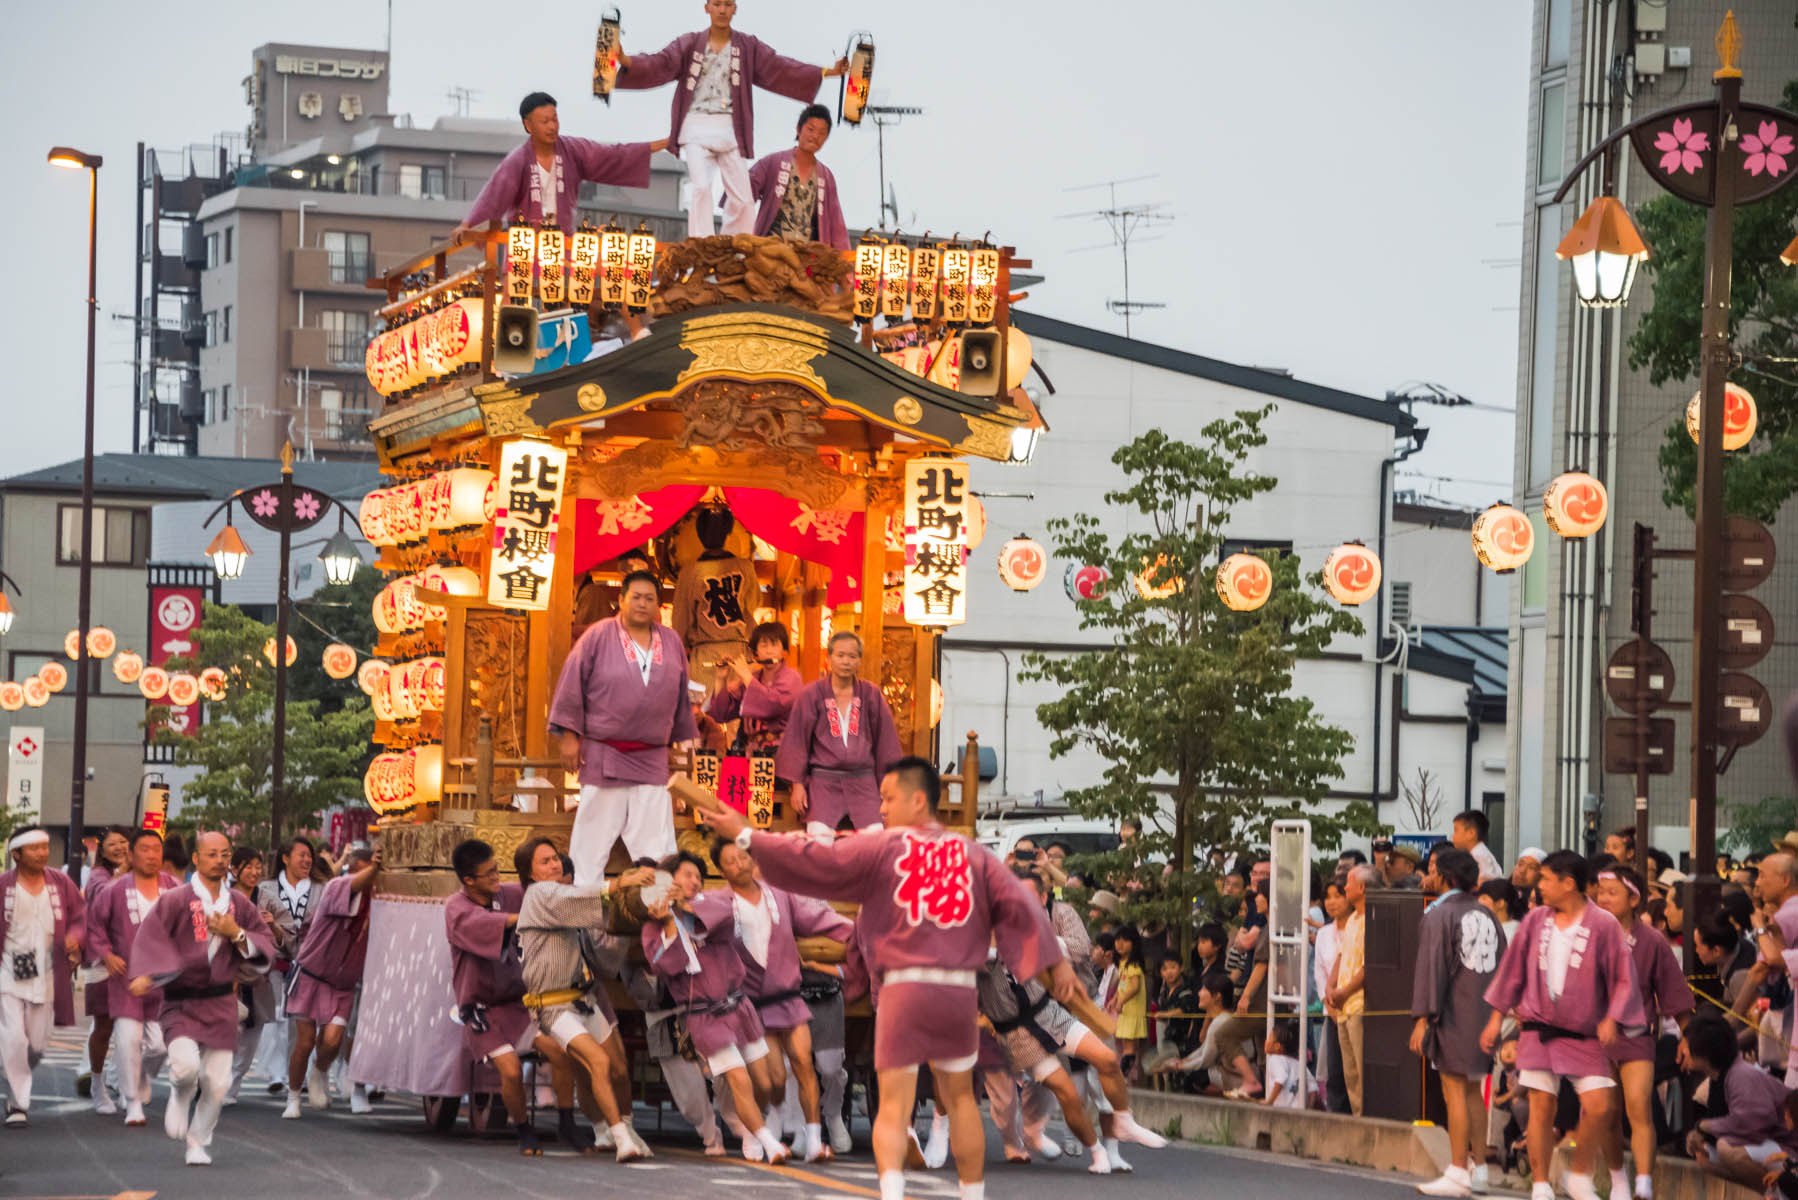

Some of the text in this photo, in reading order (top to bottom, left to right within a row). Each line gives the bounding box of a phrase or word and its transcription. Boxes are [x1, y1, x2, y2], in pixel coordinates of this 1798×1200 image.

[276, 55, 385, 80] 朝日プラザ
[498, 453, 560, 602] 北町櫻會
[911, 467, 964, 616] 北町櫻會
